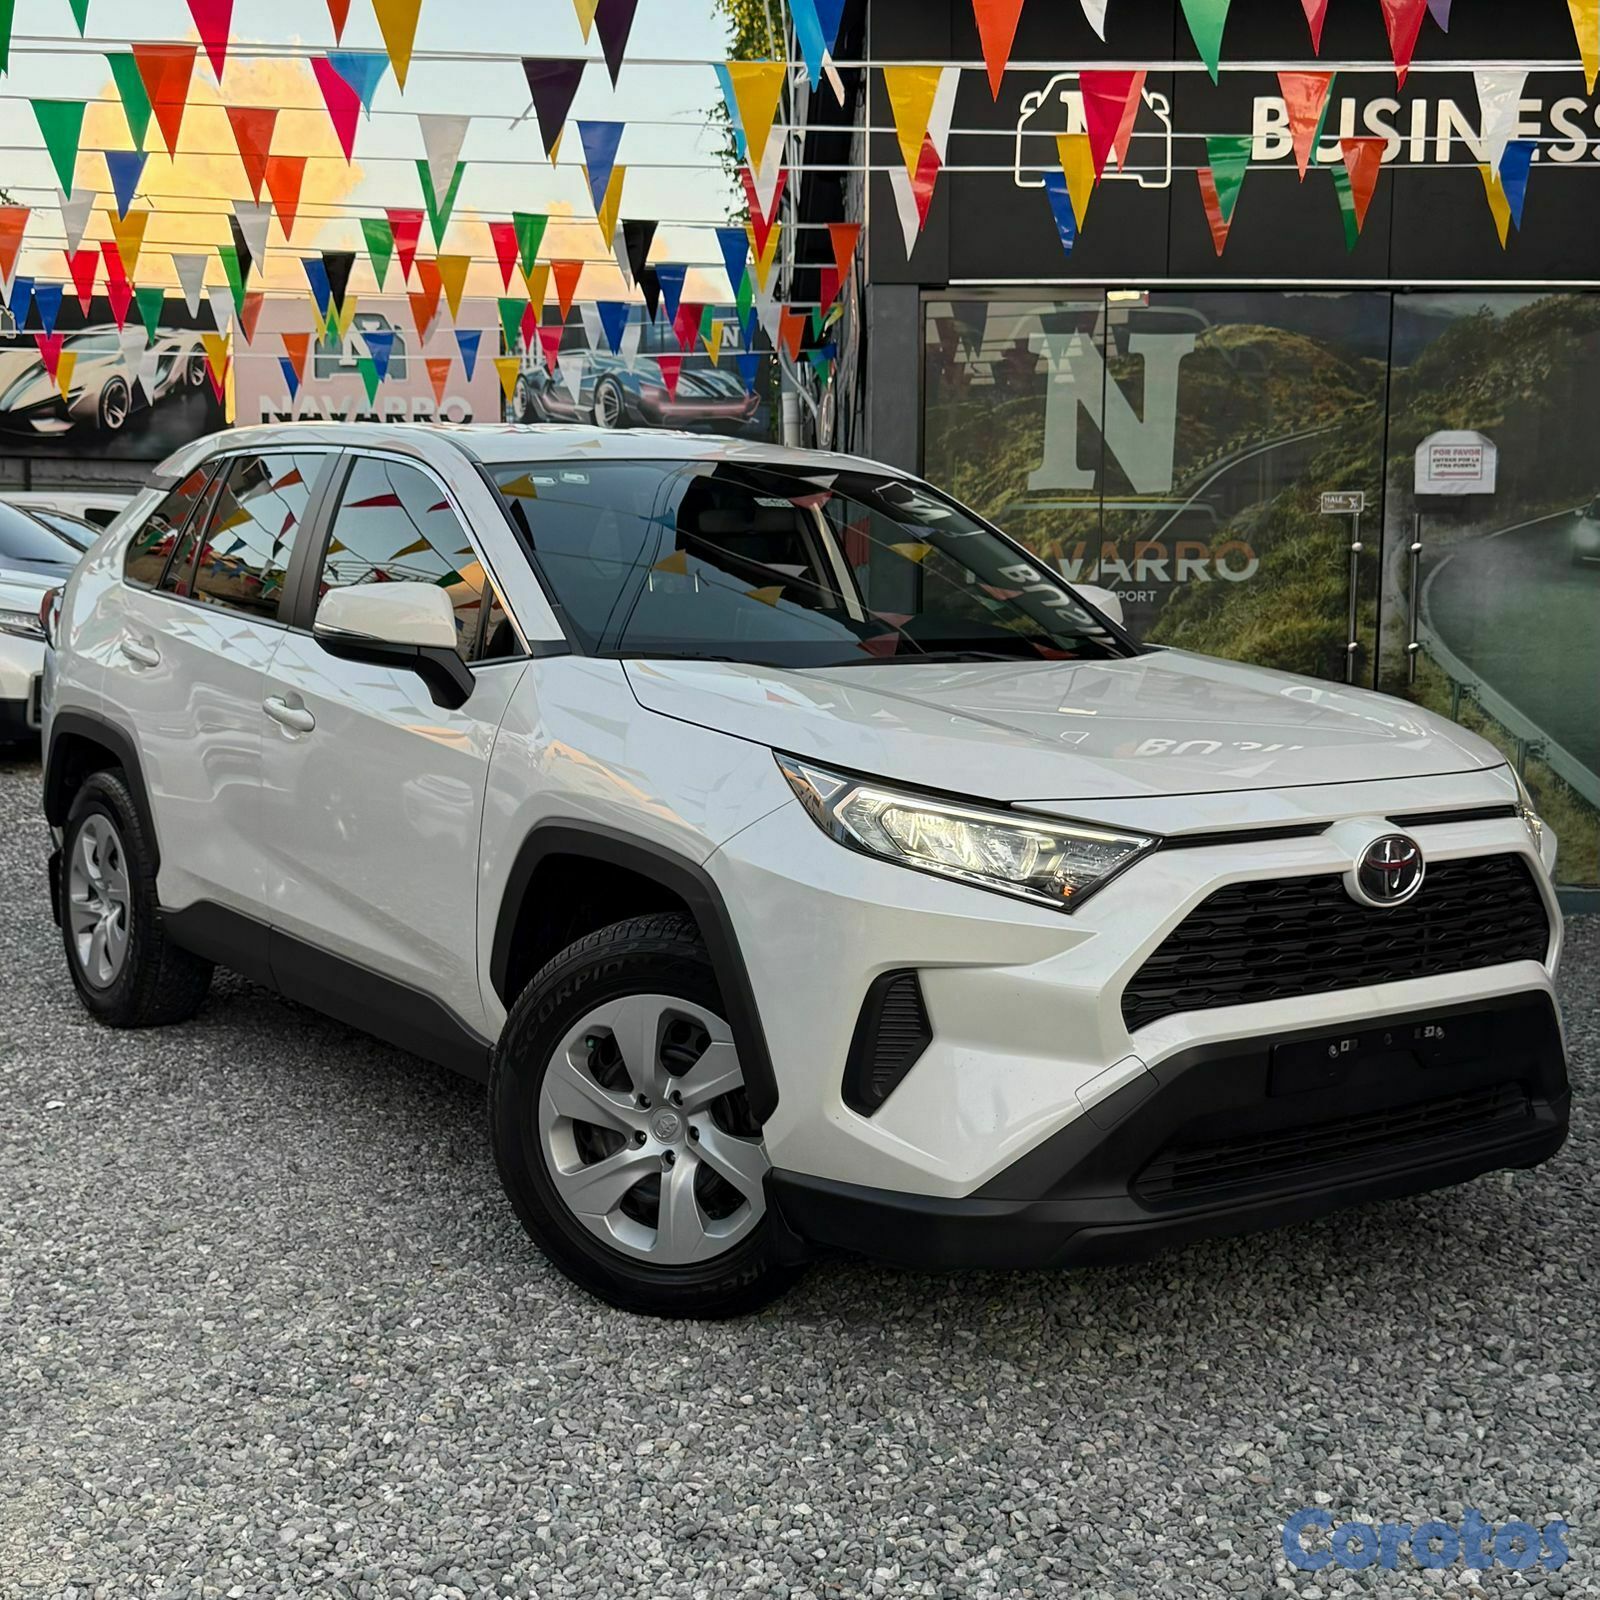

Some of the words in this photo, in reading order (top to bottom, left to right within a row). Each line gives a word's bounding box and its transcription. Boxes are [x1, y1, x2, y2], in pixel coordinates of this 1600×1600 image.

[1252, 97, 1600, 163] BUSINES
[258, 394, 474, 425] NAVARRO
[1027, 332, 1196, 494] N
[1453, 448, 1480, 456] FAVOR
[1022, 541, 1259, 582] VARRO
[1116, 590, 1157, 602] PORT
